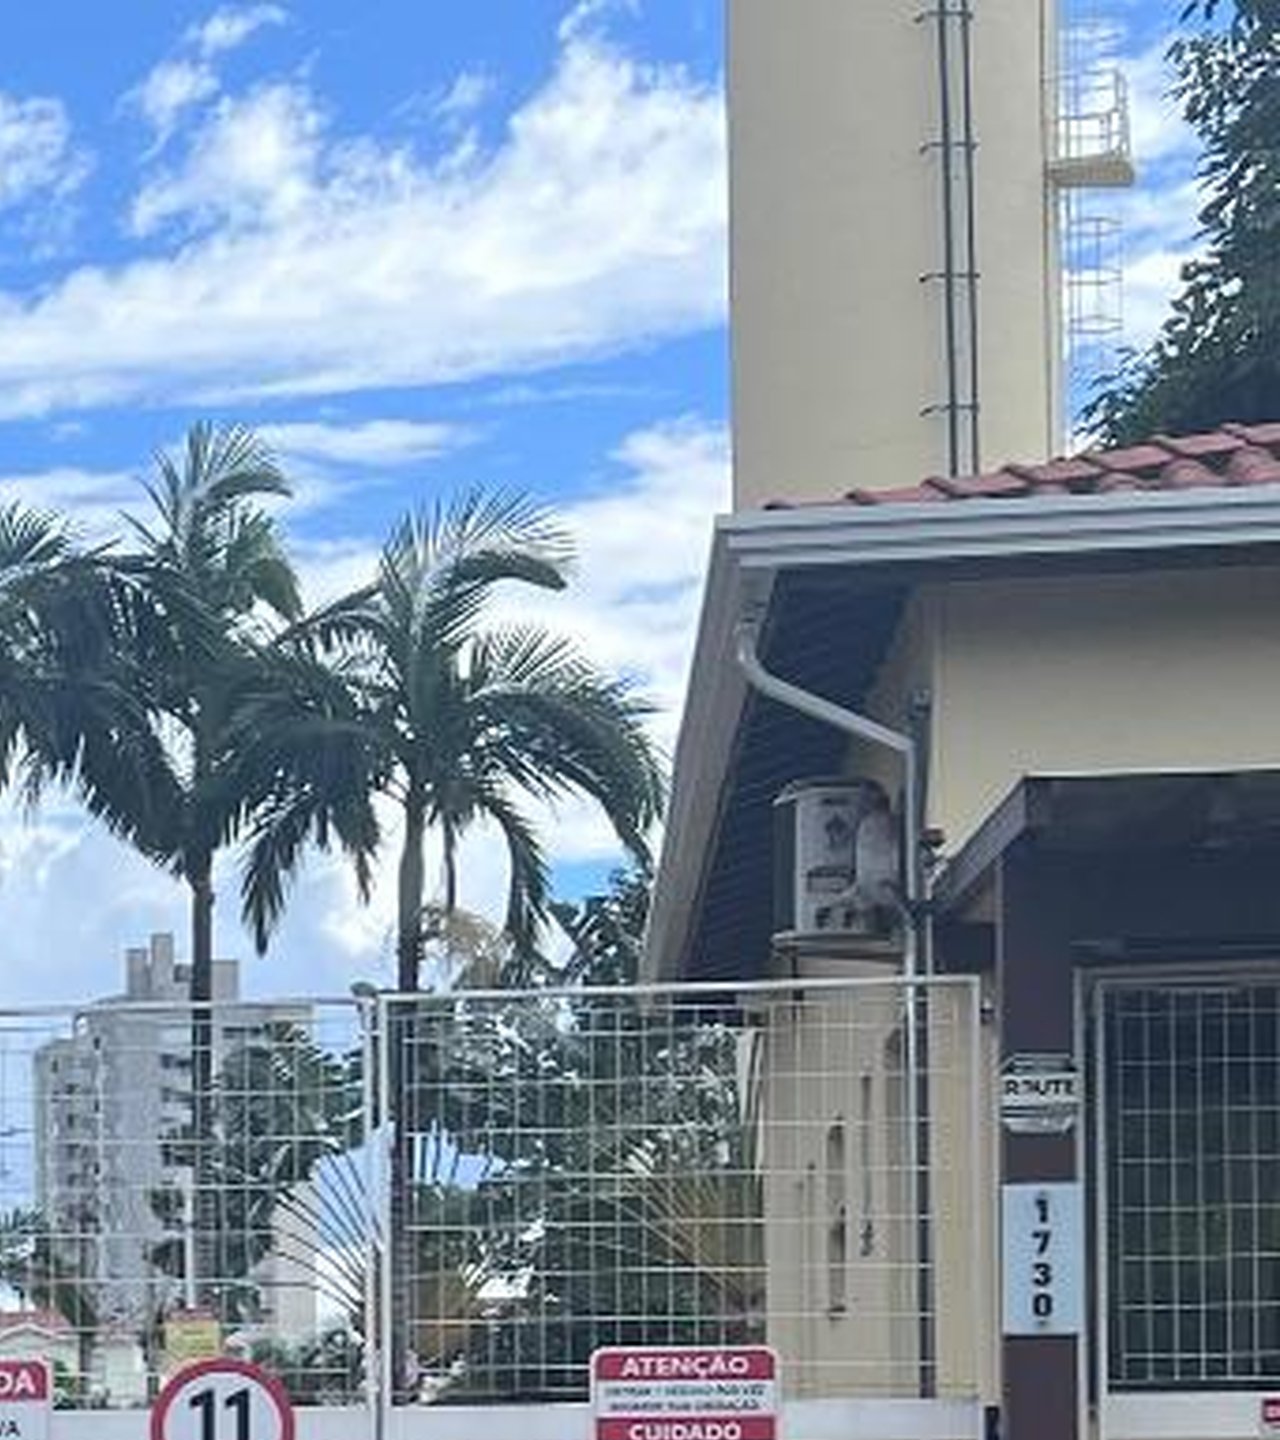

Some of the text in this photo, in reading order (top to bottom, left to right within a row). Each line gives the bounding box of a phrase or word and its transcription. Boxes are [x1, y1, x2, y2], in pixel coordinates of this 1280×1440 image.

[1005, 1079, 1075, 1096] ROUTE
[1031, 1198, 1053, 1318] 1730
[621, 1354, 750, 1379] ATENÇÃO
